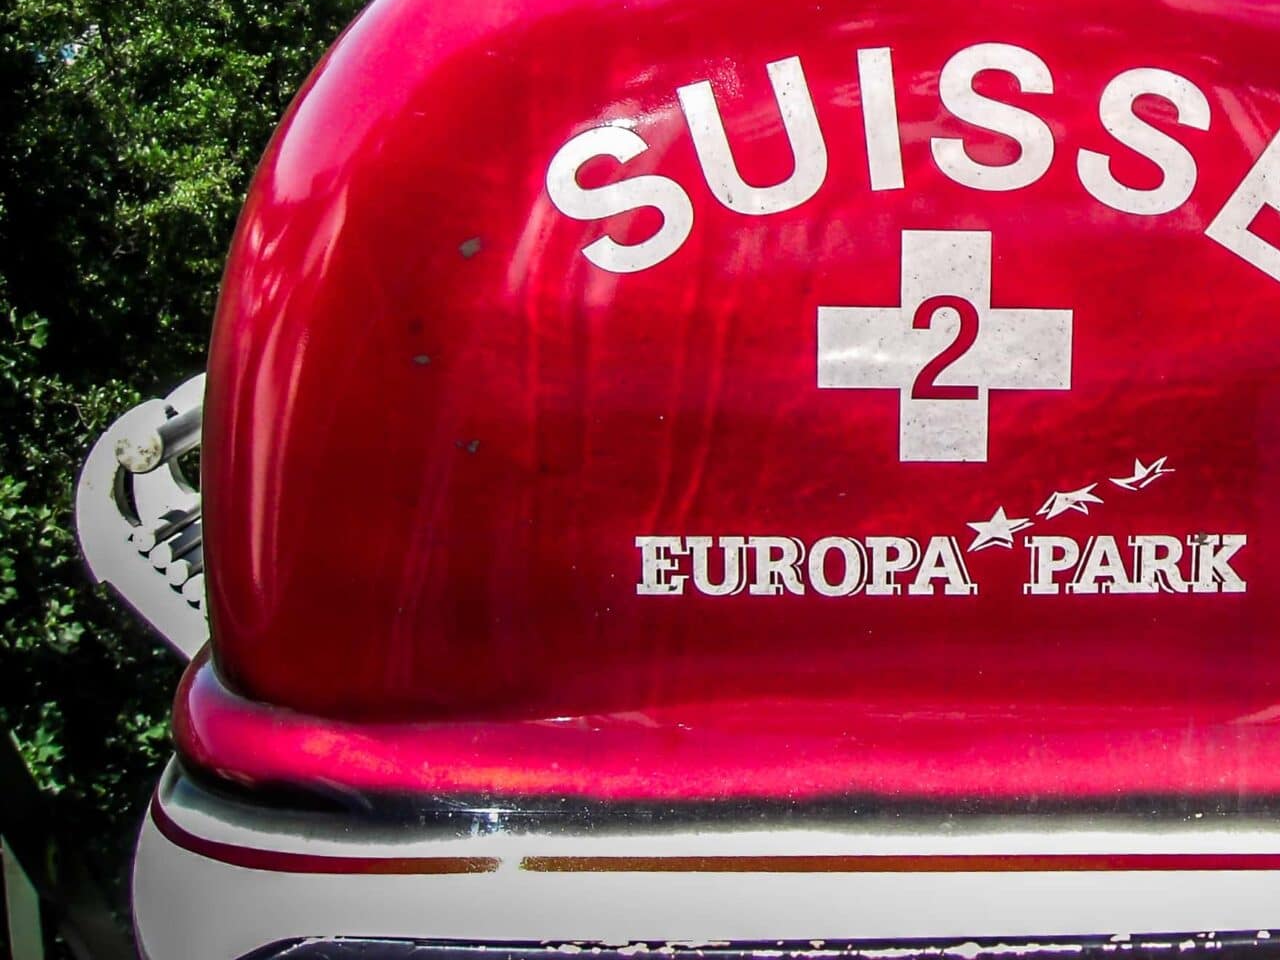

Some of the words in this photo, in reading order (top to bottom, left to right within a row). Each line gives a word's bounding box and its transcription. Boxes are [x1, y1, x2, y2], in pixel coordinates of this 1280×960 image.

[911, 294, 980, 401] 2
[635, 535, 978, 596] EUROPA
[1023, 534, 1248, 595] PARK
